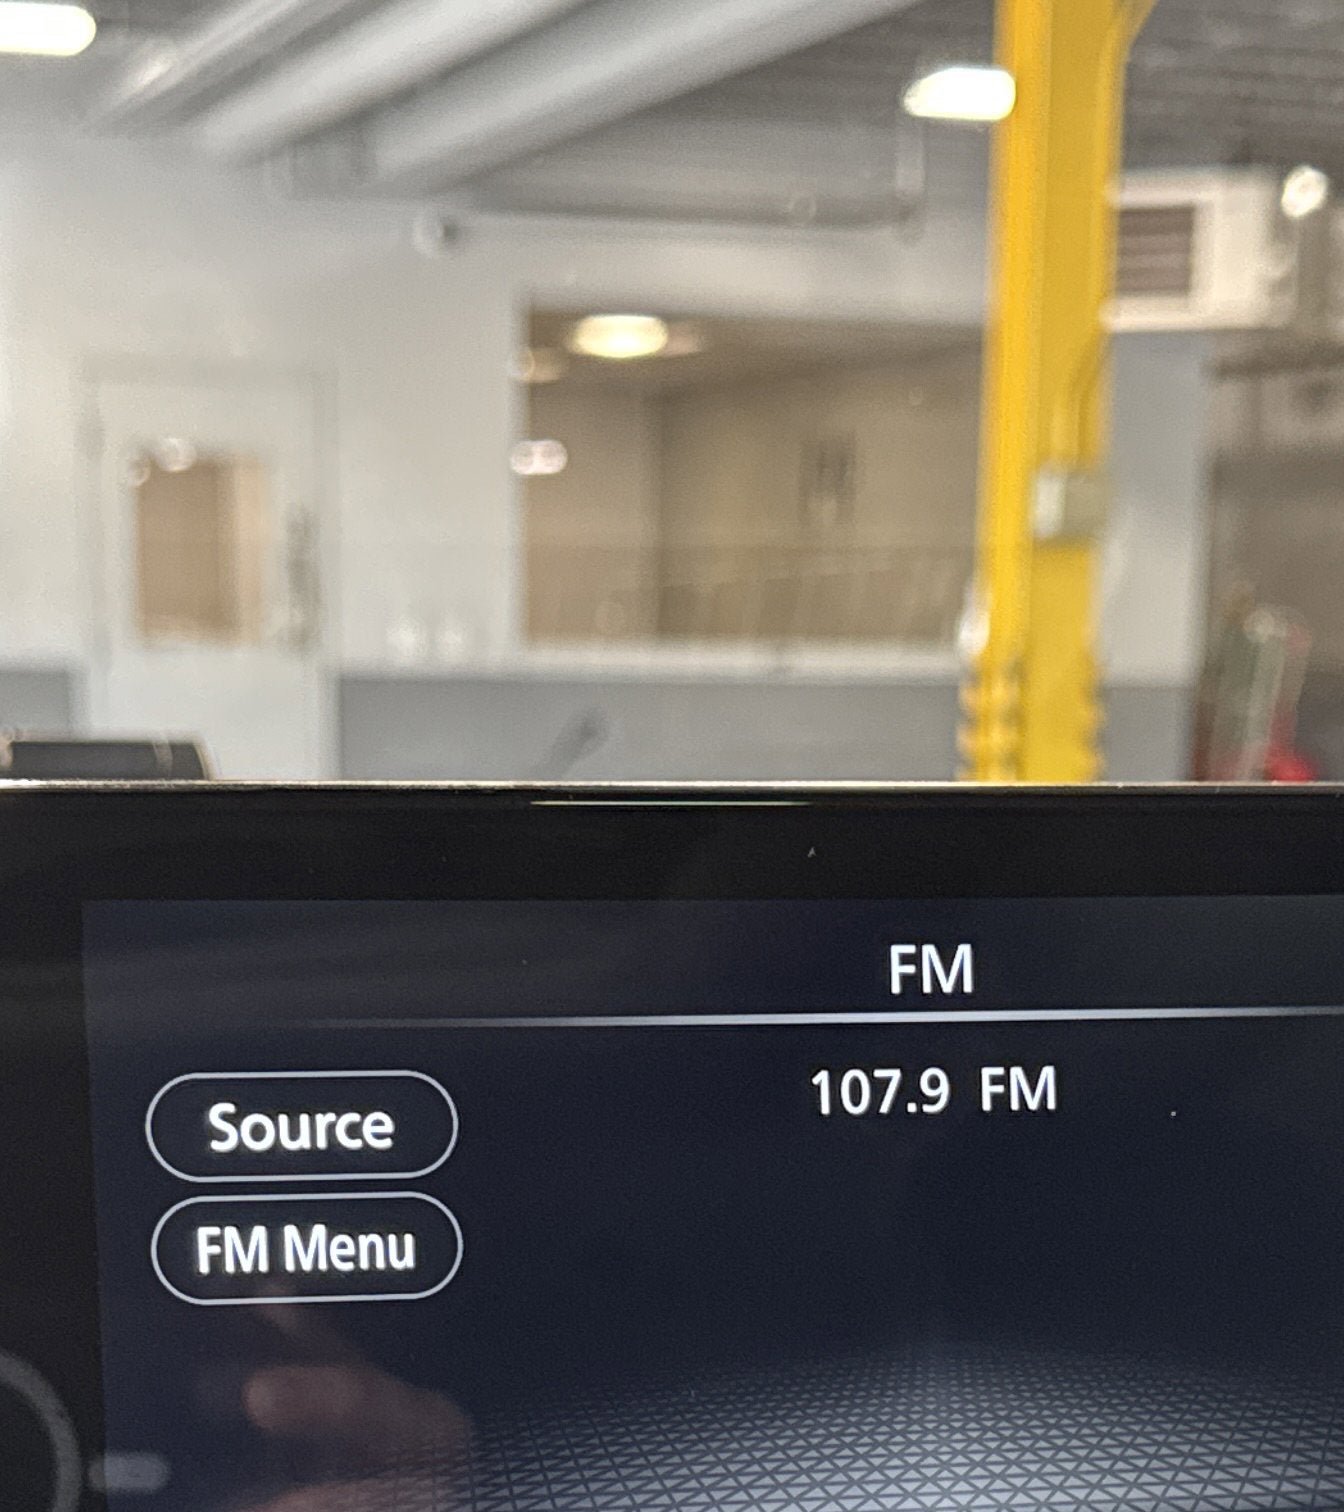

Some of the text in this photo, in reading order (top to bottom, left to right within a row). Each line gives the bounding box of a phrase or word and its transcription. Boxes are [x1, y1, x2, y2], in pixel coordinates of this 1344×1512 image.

[890, 943, 973, 995] FM
[811, 1065, 1056, 1115] 107.9 FM
[208, 1102, 395, 1153] Source
[196, 1223, 415, 1275] FM Menu
